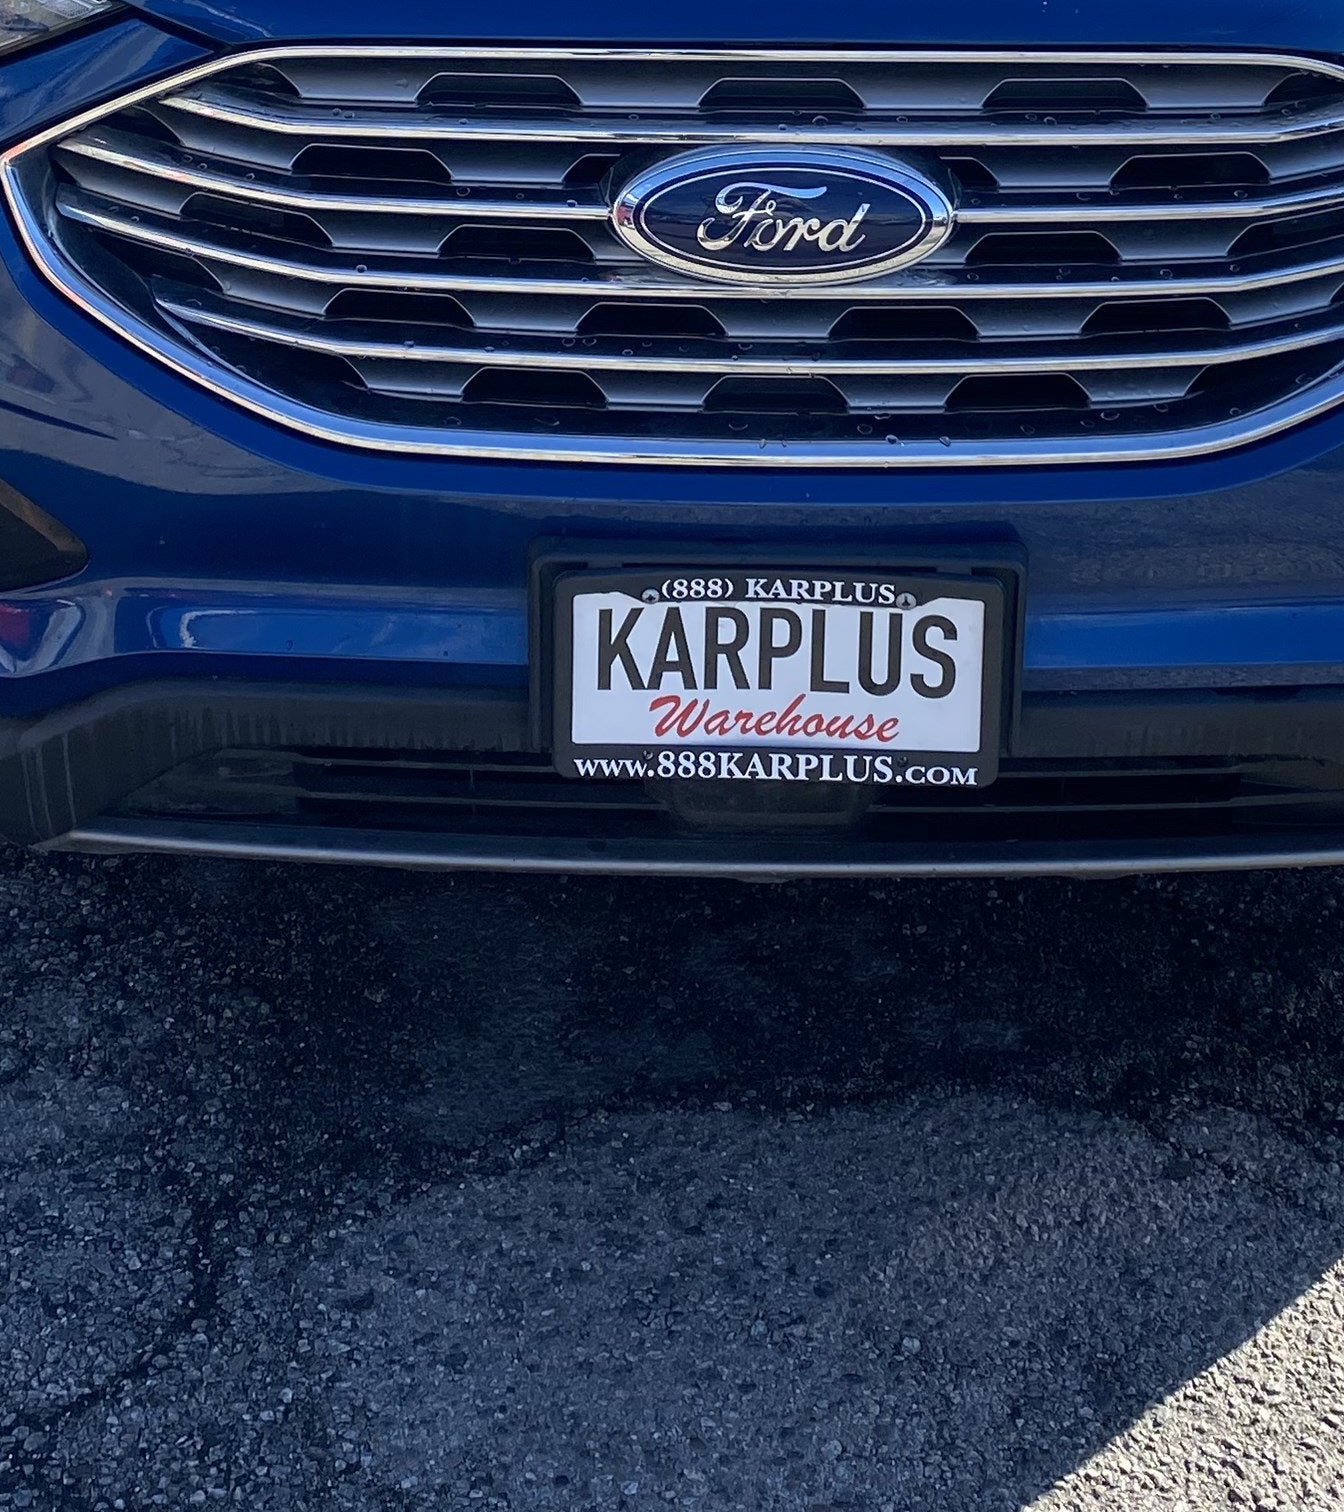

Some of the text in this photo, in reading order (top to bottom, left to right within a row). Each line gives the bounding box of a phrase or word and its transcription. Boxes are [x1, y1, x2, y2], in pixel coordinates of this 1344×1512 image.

[696, 181, 871, 252] Ford
[661, 577, 897, 605] (888) KARPLUS
[597, 606, 958, 699] KARPLUS
[649, 693, 900, 743] Warehouse
